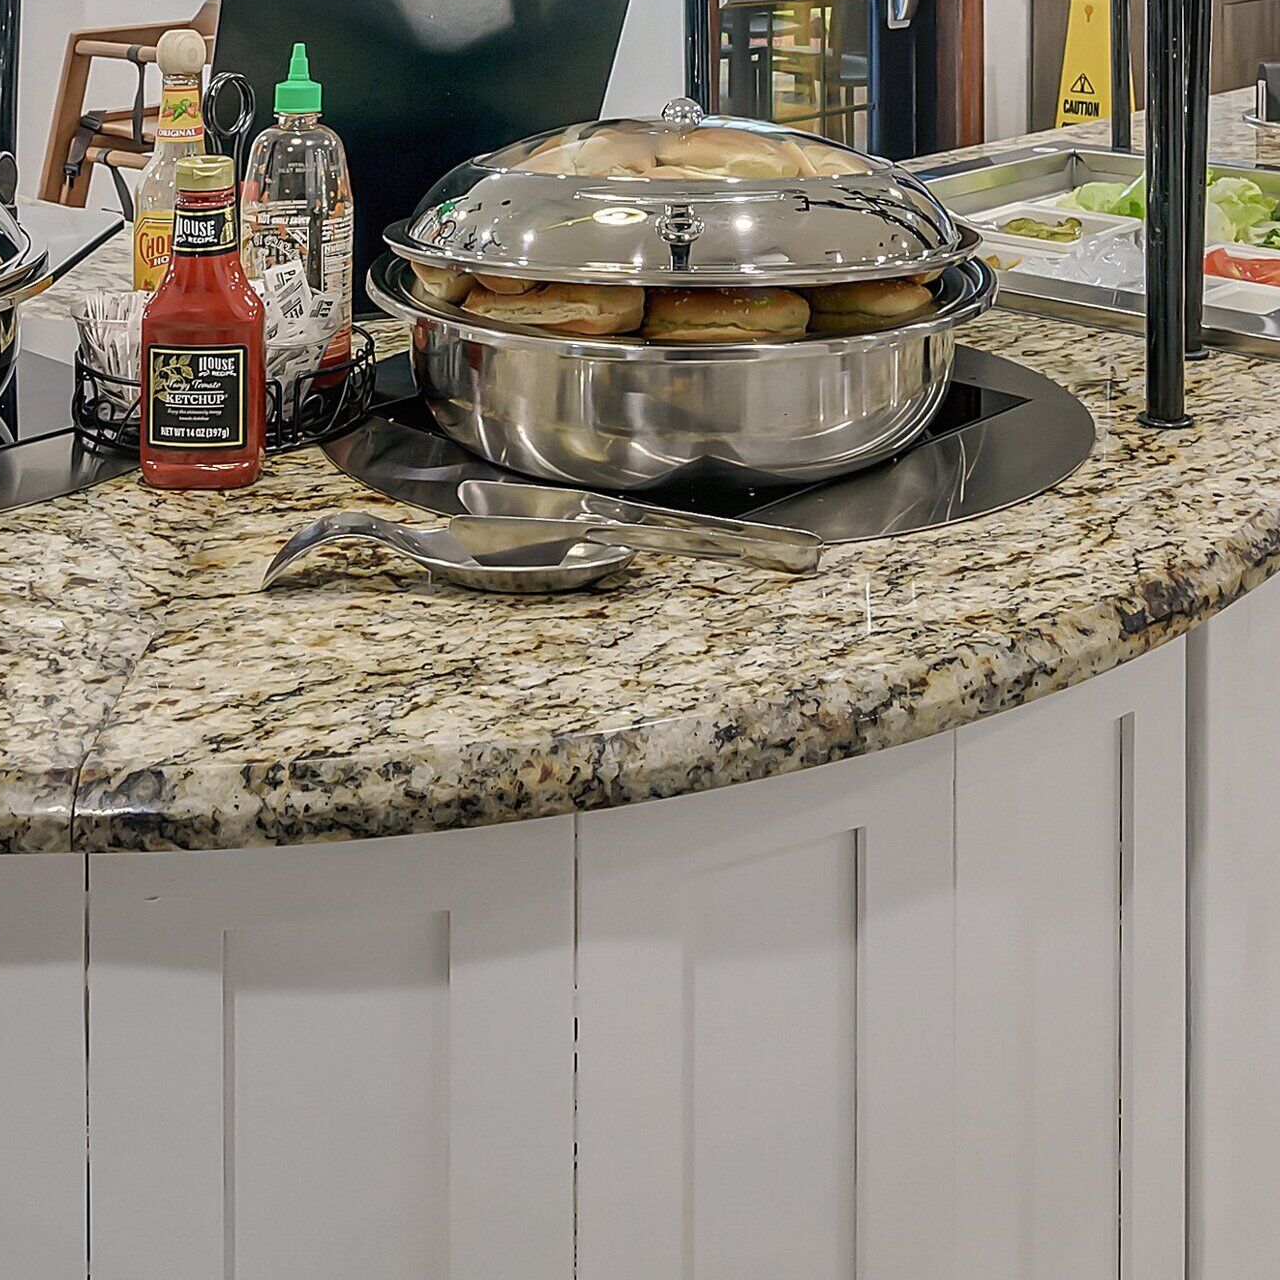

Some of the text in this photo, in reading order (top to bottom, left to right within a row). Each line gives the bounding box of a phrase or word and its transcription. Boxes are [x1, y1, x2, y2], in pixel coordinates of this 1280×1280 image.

[1063, 99, 1100, 117] CAUTION
[158, 129, 196, 137] ORIGINAL
[176, 215, 216, 237] HOUSE
[198, 356, 236, 371] HOUSE
[160, 426, 230, 439] NET WT 14 OZ (397g)
